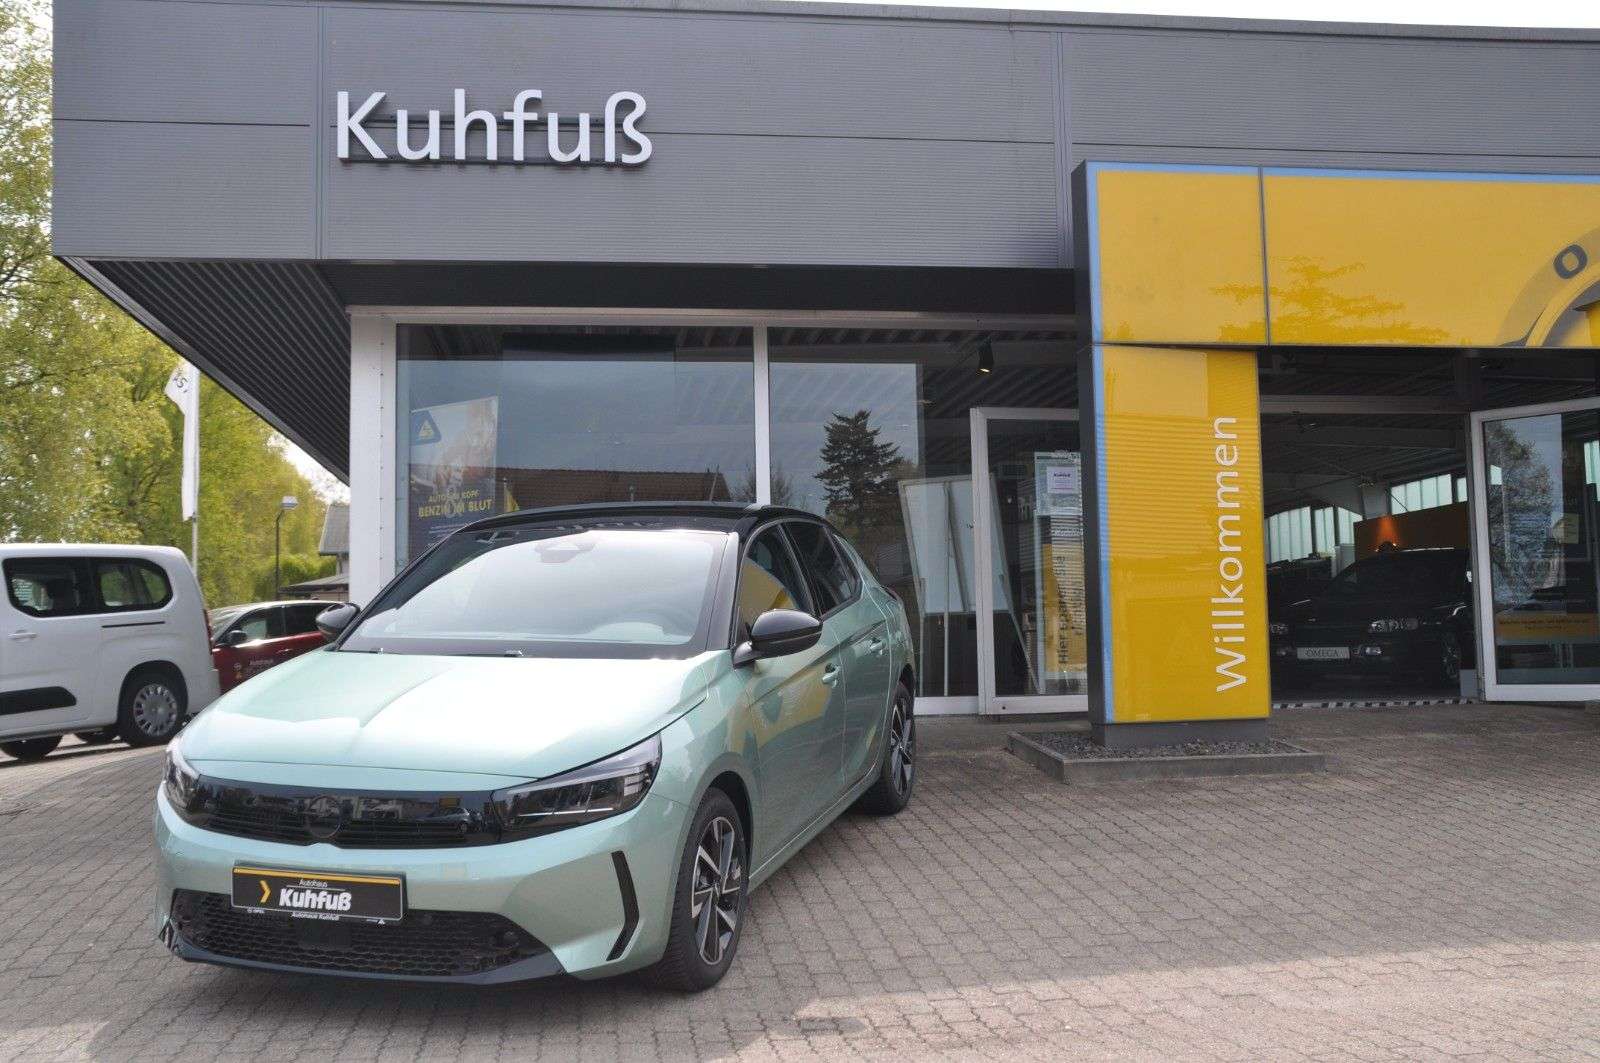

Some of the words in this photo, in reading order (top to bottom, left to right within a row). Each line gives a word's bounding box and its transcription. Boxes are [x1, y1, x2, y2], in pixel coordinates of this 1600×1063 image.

[337, 88, 652, 164] Kuhfuß
[468, 499, 492, 512] BLUT
[1211, 416, 1247, 693] Willkommen
[279, 888, 352, 911] Kuhfuß
